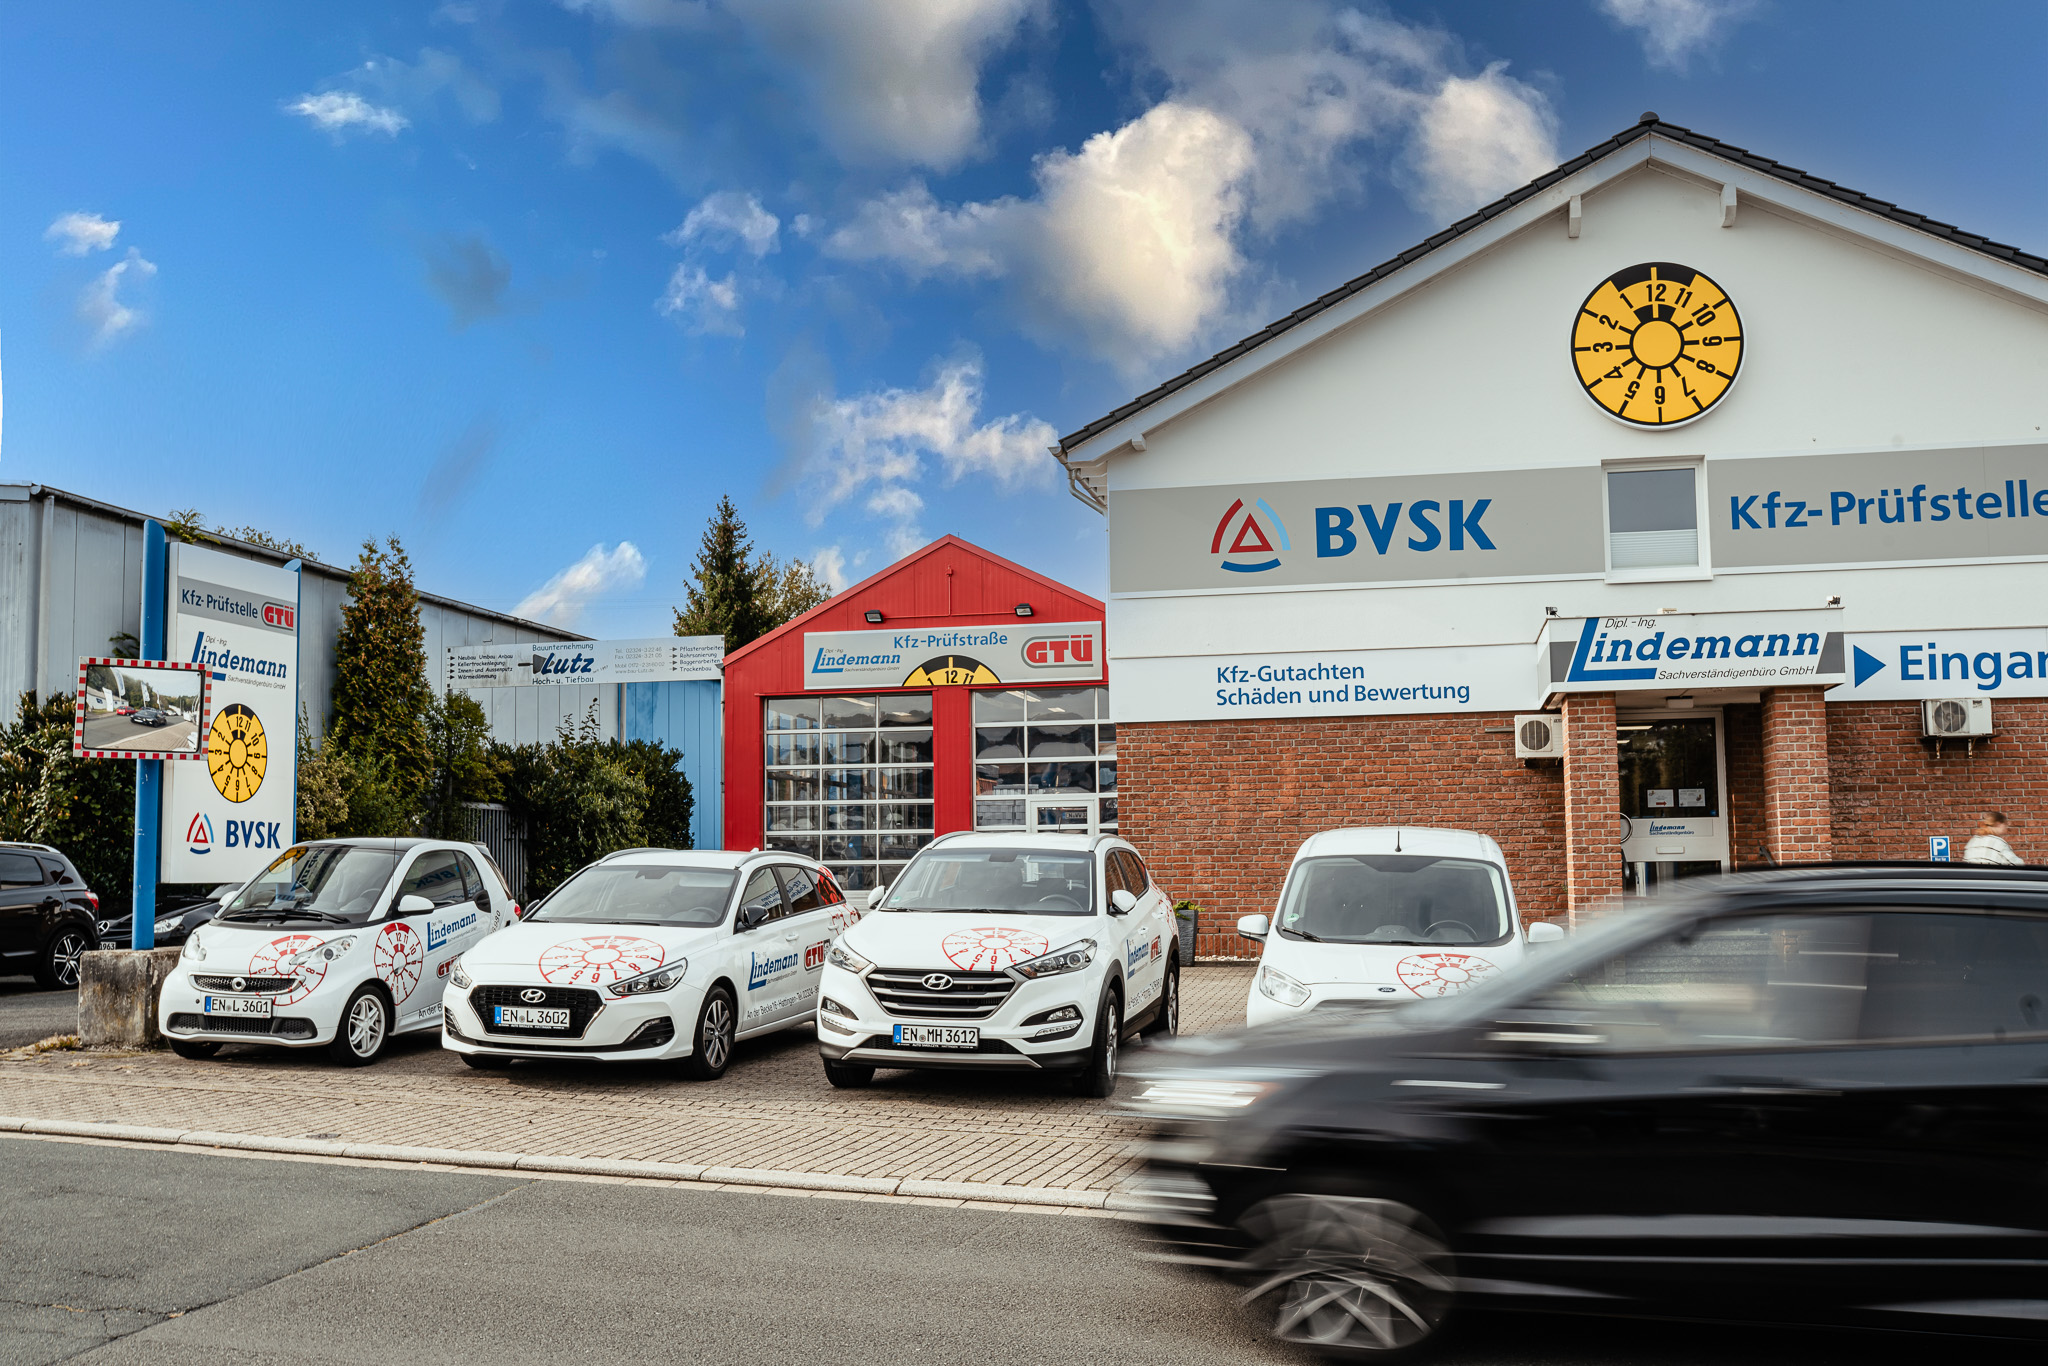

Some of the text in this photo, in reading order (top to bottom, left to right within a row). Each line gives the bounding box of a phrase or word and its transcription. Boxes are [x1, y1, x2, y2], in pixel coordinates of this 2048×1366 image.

[1619, 293, 1634, 309] 1
[1646, 284, 1667, 302] 12
[1674, 288, 1693, 308] 11
[1598, 314, 1619, 330] 2
[1691, 303, 1716, 327] 10
[1593, 342, 1614, 352] 3
[1604, 366, 1624, 379] 4
[1696, 360, 1716, 374] 8
[1624, 380, 1640, 400] 5
[1681, 376, 1696, 398] 7
[1315, 499, 1497, 558] BVSK
[263, 605, 295, 628] GTÜ
[1605, 618, 1628, 629] Dipl.
[532, 643, 594, 652] Bauunternehmung
[894, 631, 1008, 649] Kfz-Prüfstraße
[191, 631, 287, 681] Lindemann
[1026, 634, 1093, 664] GTÜ
[1567, 617, 1820, 682] Lindemann
[541, 652, 594, 675] Lutz
[811, 648, 901, 673] Lindemann
[945, 670, 958, 684] 12
[1217, 663, 1365, 683] Kfz-Gutachten
[1658, 665, 1815, 680] Sachverständigenbüro GmbH
[1216, 684, 1471, 706] Schäden und Bewertung
[236, 716, 243, 727] 12
[245, 720, 251, 732] 11
[218, 732, 226, 741] 2
[251, 733, 259, 746] 10
[251, 766, 258, 775] 8
[225, 775, 231, 786] 5
[1650, 821, 1685, 831] Lindemann
[226, 820, 281, 849] BVSK
[1933, 839, 1946, 855] P
[396, 932, 401, 942] 12
[427, 913, 476, 952] Lindemann
[806, 941, 824, 967] GTÜ
[973, 954, 982, 963] 5
[571, 970, 583, 980] 5
[748, 952, 798, 991] Lindemann
[212, 999, 269, 1013] EN L 3601
[503, 1010, 568, 1024] EN L 3602
[903, 1028, 975, 1043] EN MH 3612
